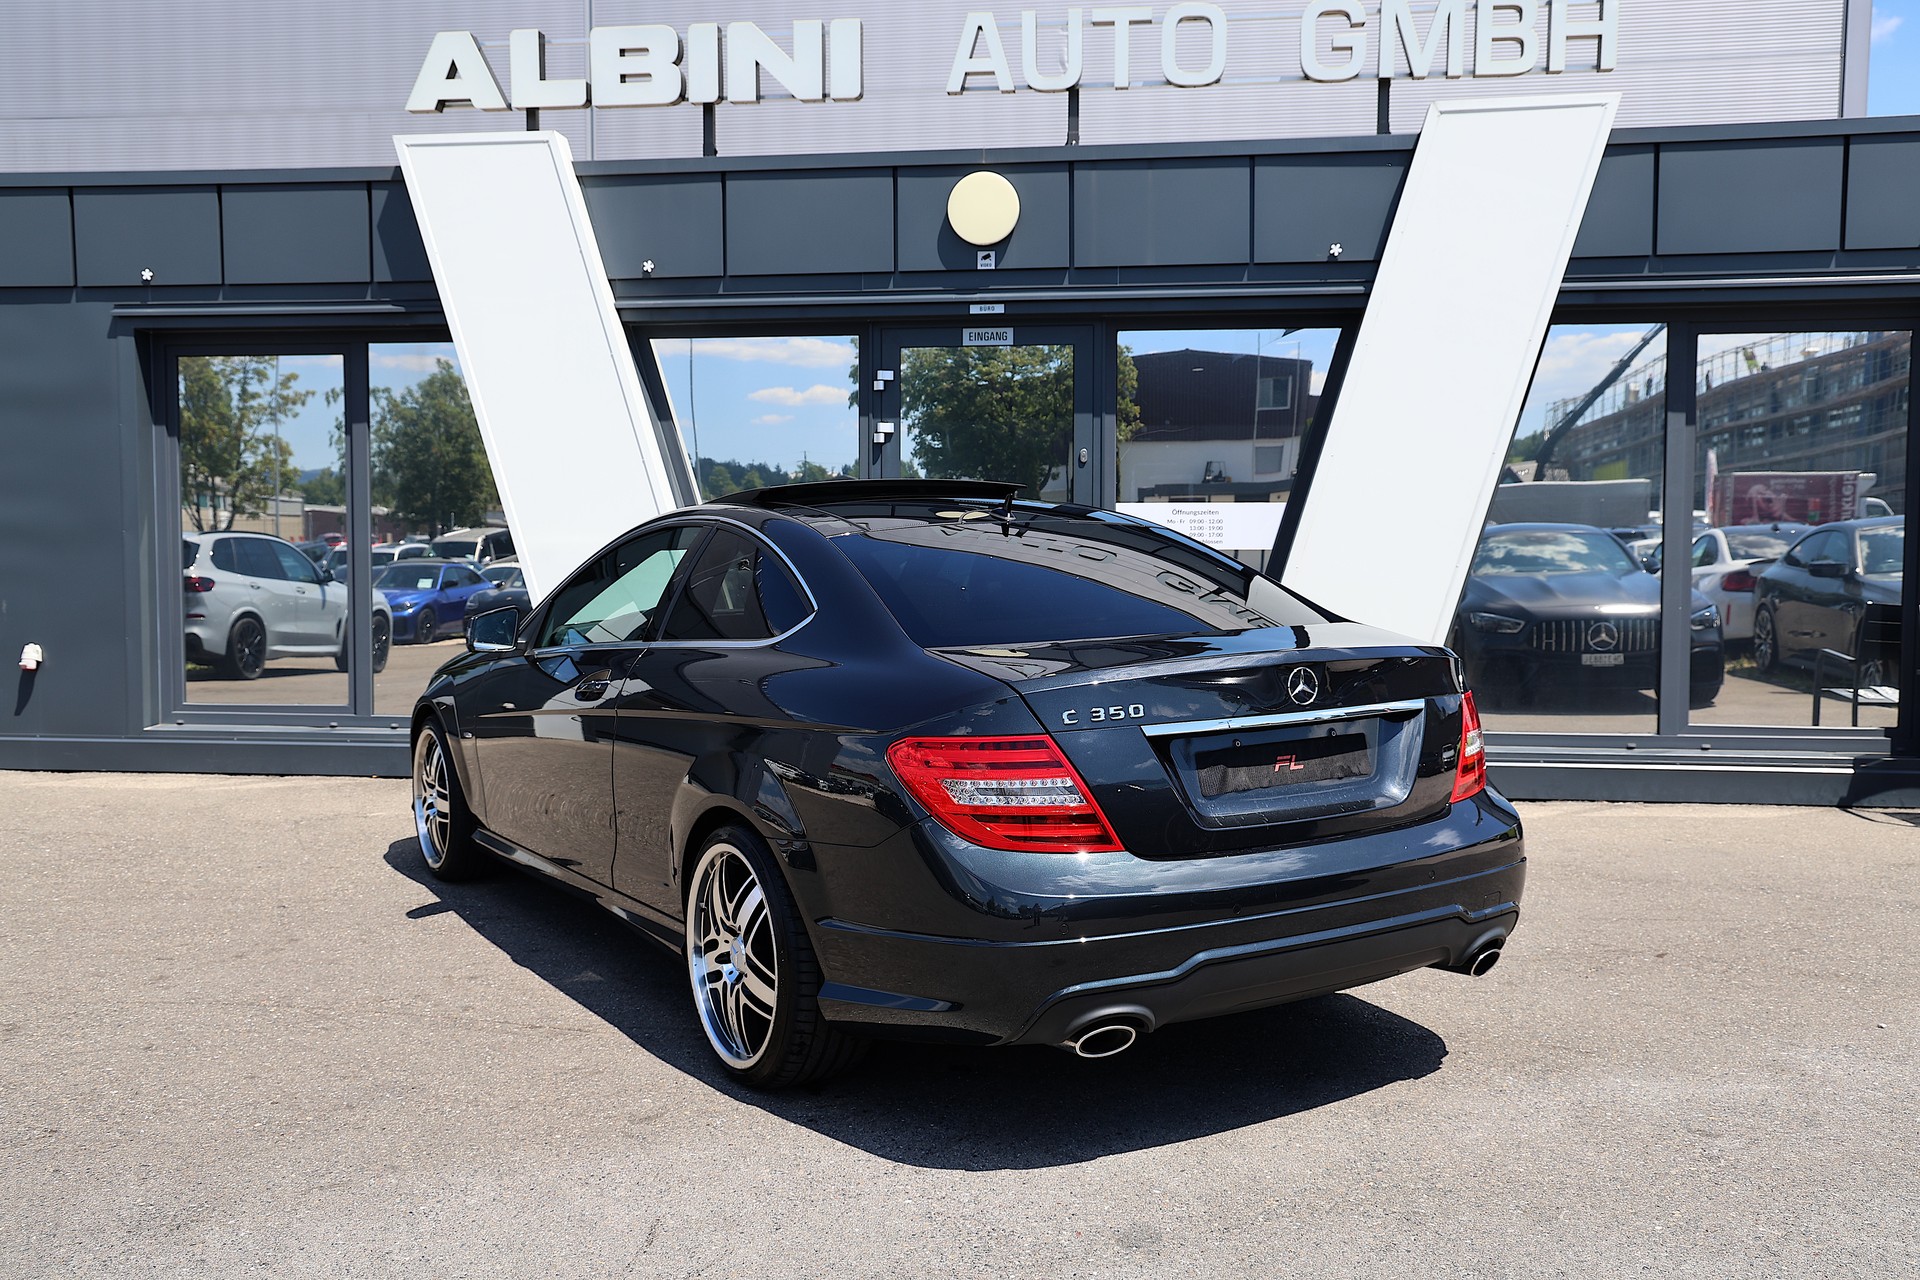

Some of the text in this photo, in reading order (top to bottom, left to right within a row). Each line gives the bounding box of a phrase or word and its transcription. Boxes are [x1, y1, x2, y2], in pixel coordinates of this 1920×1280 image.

[405, 0, 1617, 113] ALBINI AUTO GMBH
[968, 331, 1008, 341] EINGANG
[1171, 508, 1219, 516] Öffnungszeiten
[1062, 703, 1145, 725] C 350
[1274, 754, 1304, 772] FL
